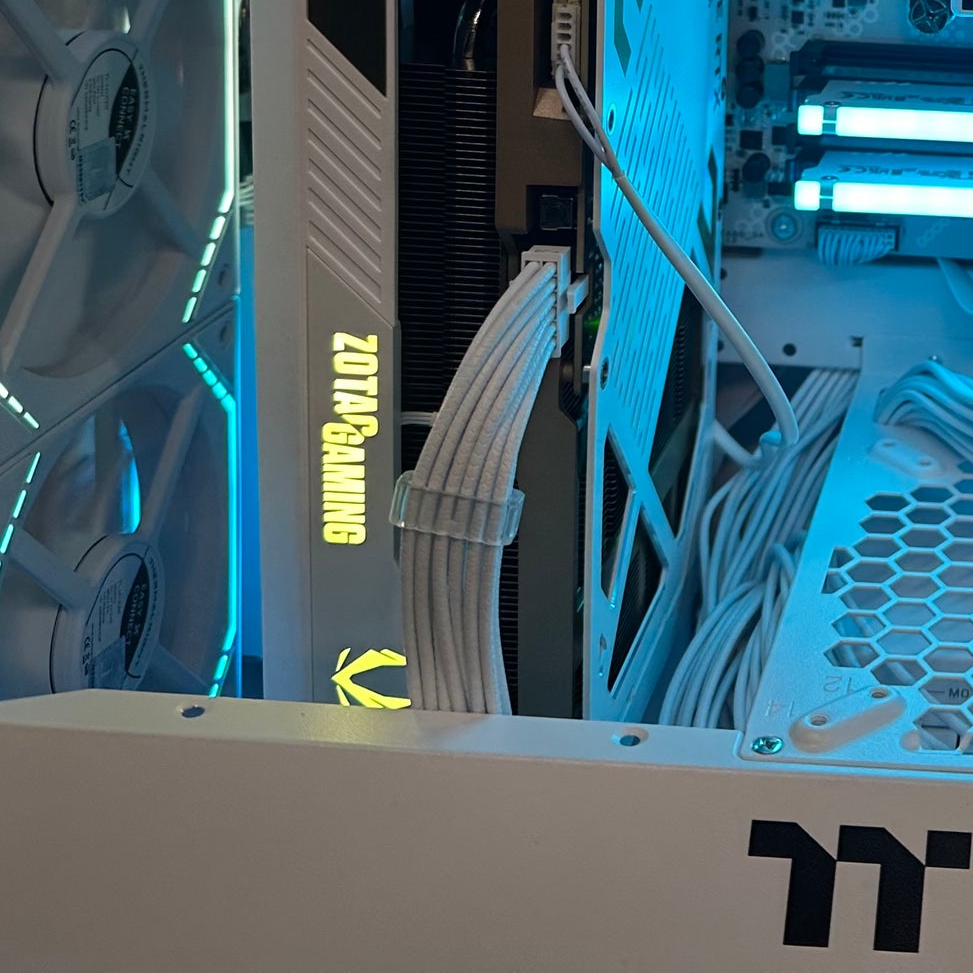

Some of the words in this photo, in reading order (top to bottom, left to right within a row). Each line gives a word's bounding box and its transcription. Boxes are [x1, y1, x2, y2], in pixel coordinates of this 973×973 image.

[115, 85, 130, 148] CONNECT
[124, 88, 137, 124] EASY
[332, 331, 379, 438] ZOTAC
[321, 421, 366, 546] GAMING
